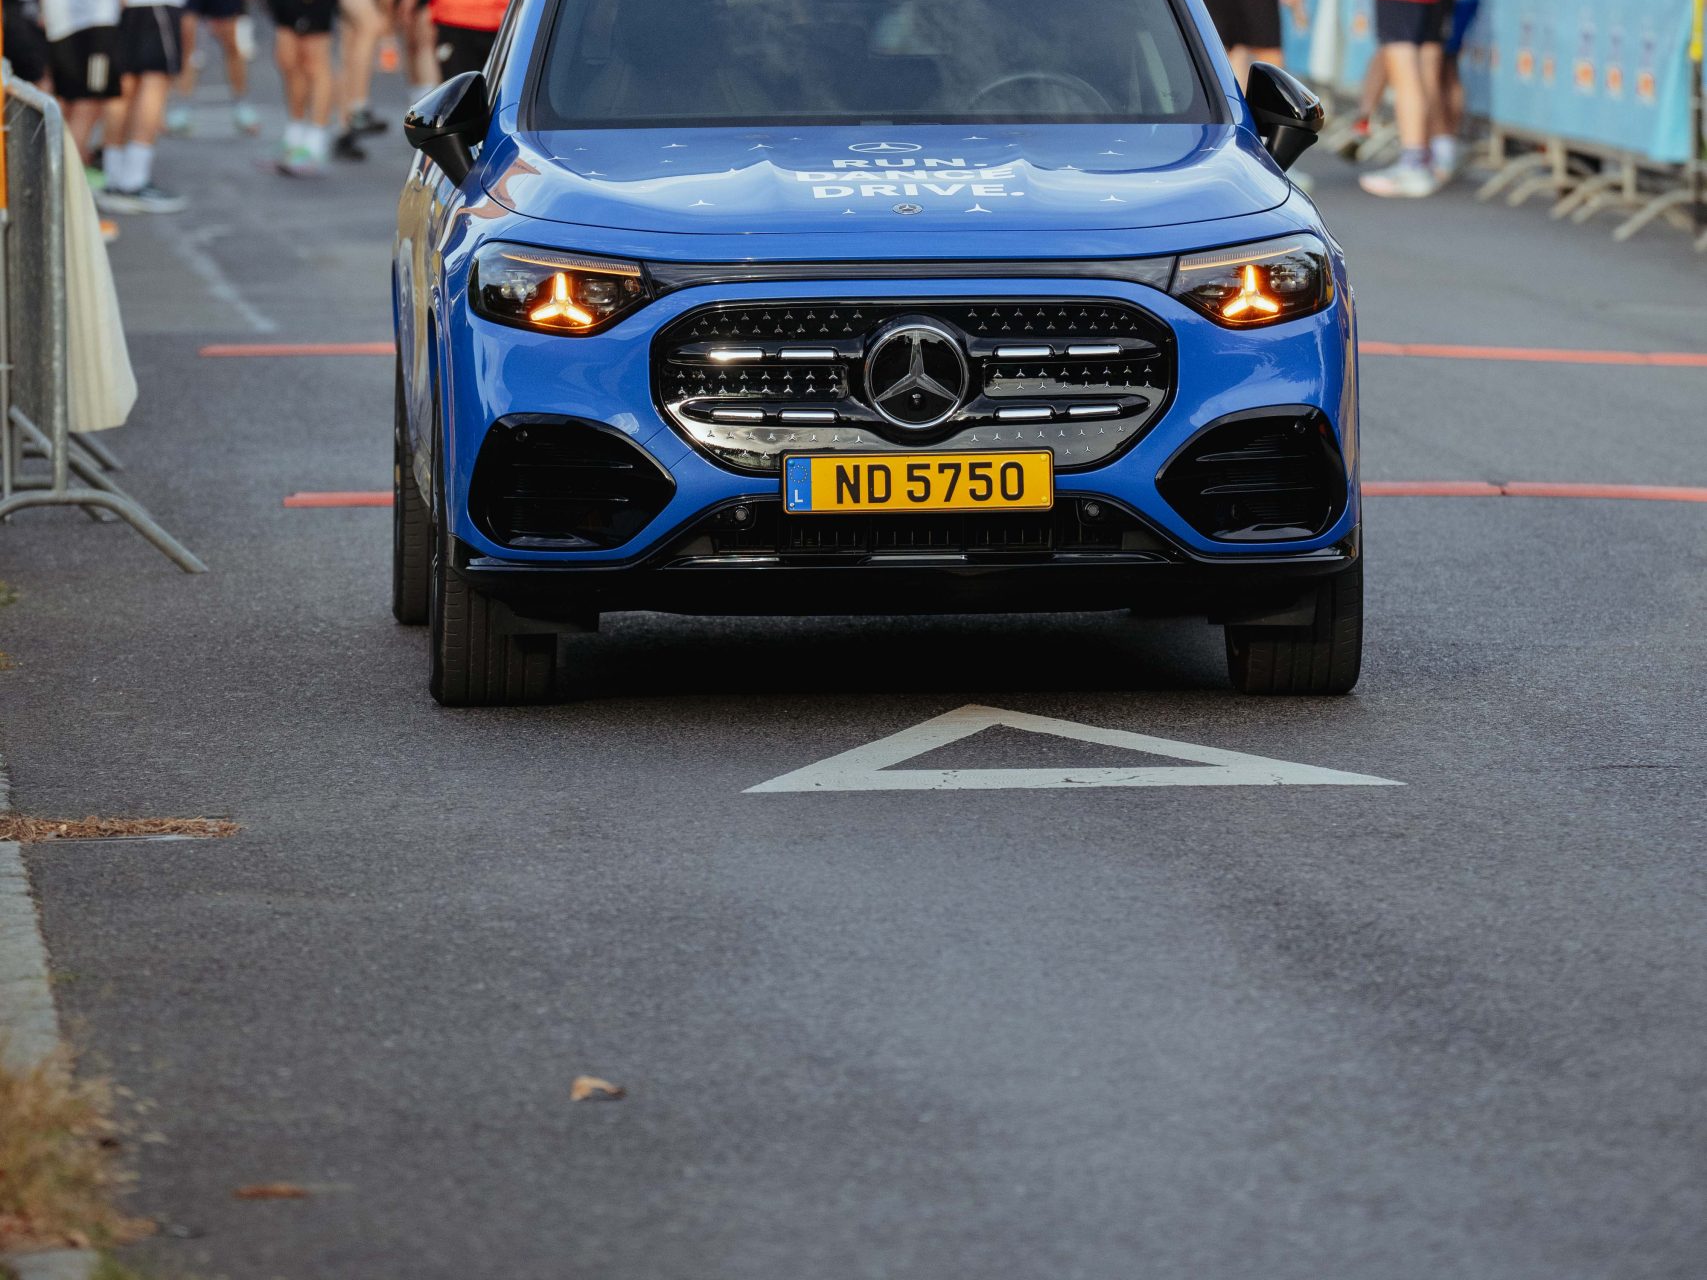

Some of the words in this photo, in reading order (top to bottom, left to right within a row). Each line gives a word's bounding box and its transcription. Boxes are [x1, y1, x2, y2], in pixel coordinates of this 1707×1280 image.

[832, 158, 988, 168] RUN.
[812, 183, 1025, 198] DRIVE.
[794, 489, 804, 503] L
[836, 464, 892, 504] ND
[906, 461, 1025, 502] 5750
